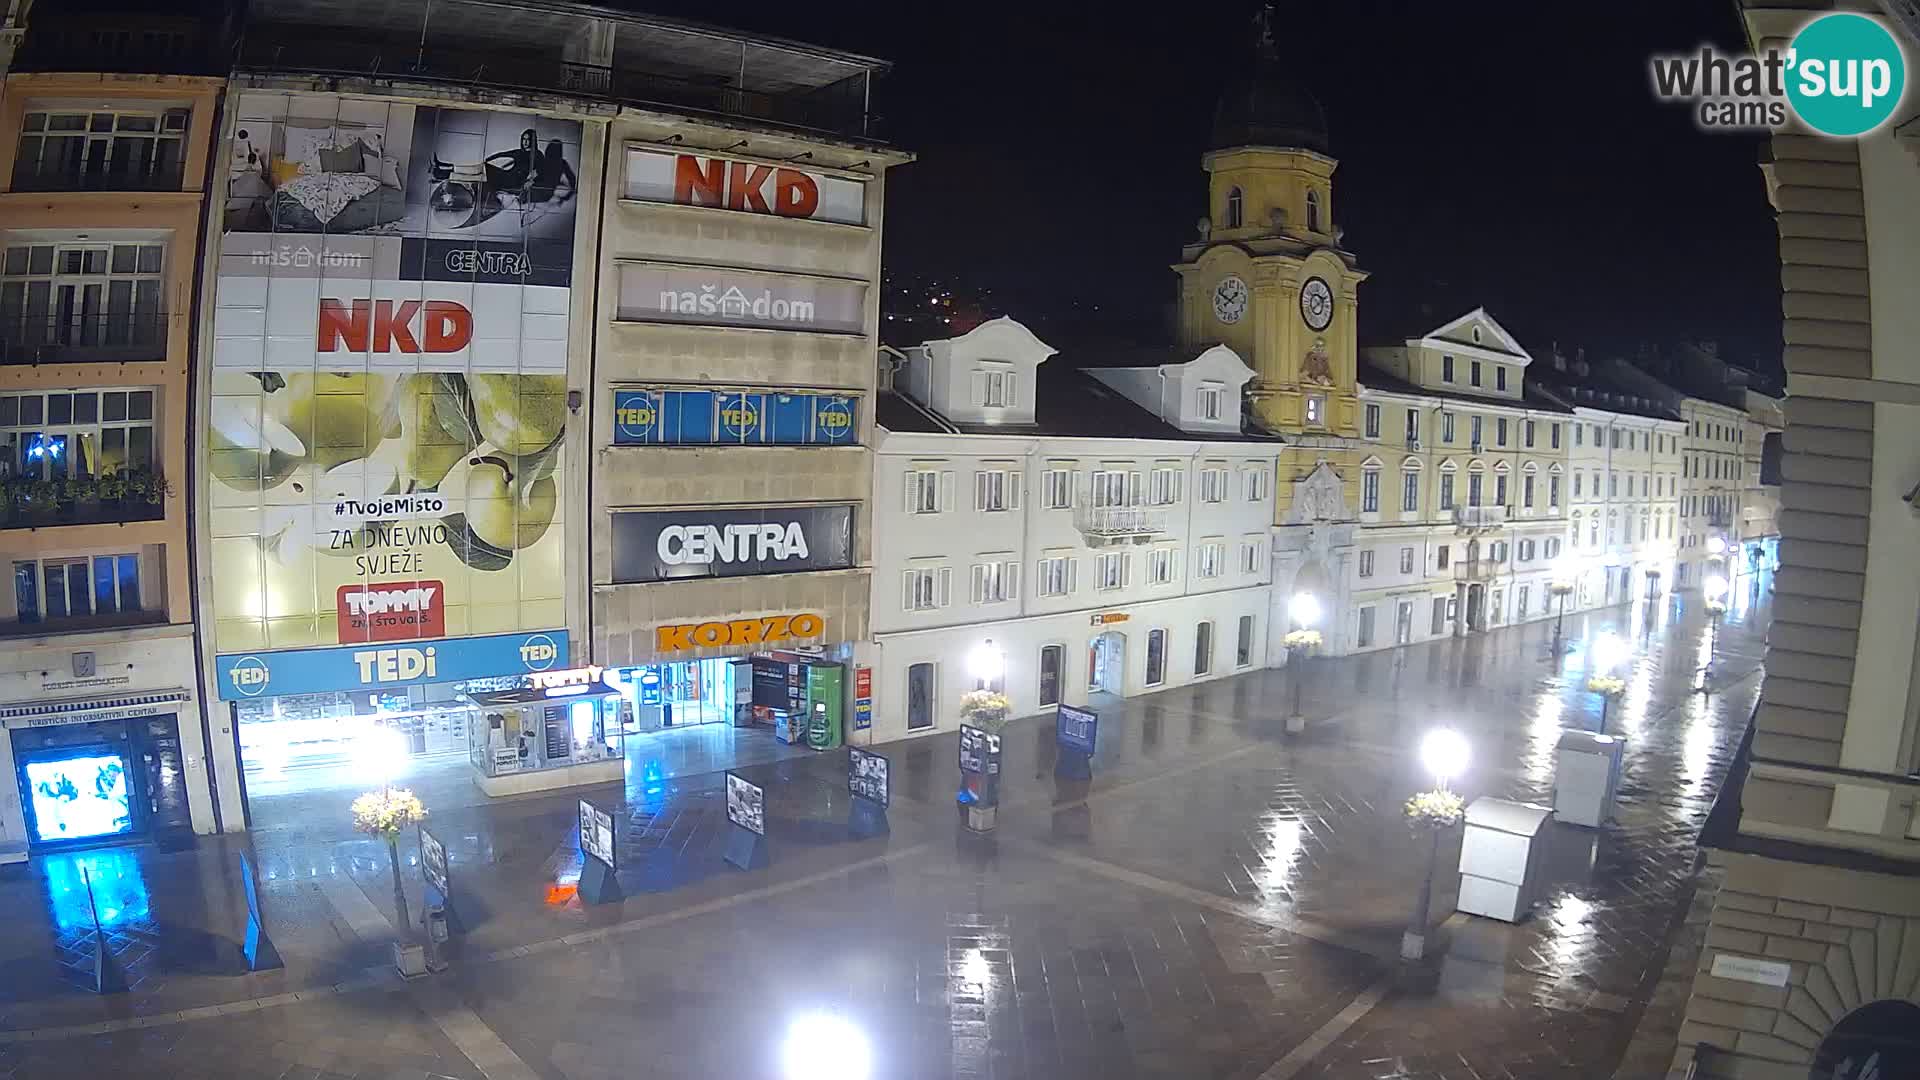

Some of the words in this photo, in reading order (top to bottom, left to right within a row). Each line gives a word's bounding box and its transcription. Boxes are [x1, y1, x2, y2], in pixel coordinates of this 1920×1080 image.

[676, 155, 819, 218] NKD
[252, 246, 290, 266] naš
[317, 248, 362, 268] dom
[445, 249, 532, 275] CENTRA
[660, 284, 715, 315] naš
[752, 290, 815, 323] dom
[317, 298, 474, 353] NKD
[617, 408, 656, 425] TEDi
[721, 409, 758, 426] TEDi
[818, 413, 851, 427] TEDi
[335, 498, 443, 517] #TvojeMisto
[331, 530, 354, 549] ZA
[364, 524, 447, 548] DNEVNO
[656, 521, 810, 565] CENTRA
[356, 548, 423, 576] SVJEŽE
[345, 588, 436, 615] TOMMY
[376, 614, 396, 626] ŠTO
[656, 613, 823, 651] KORZO
[354, 646, 436, 684] TEDi
[520, 643, 557, 662] TEDi
[230, 667, 270, 684] TEDi
